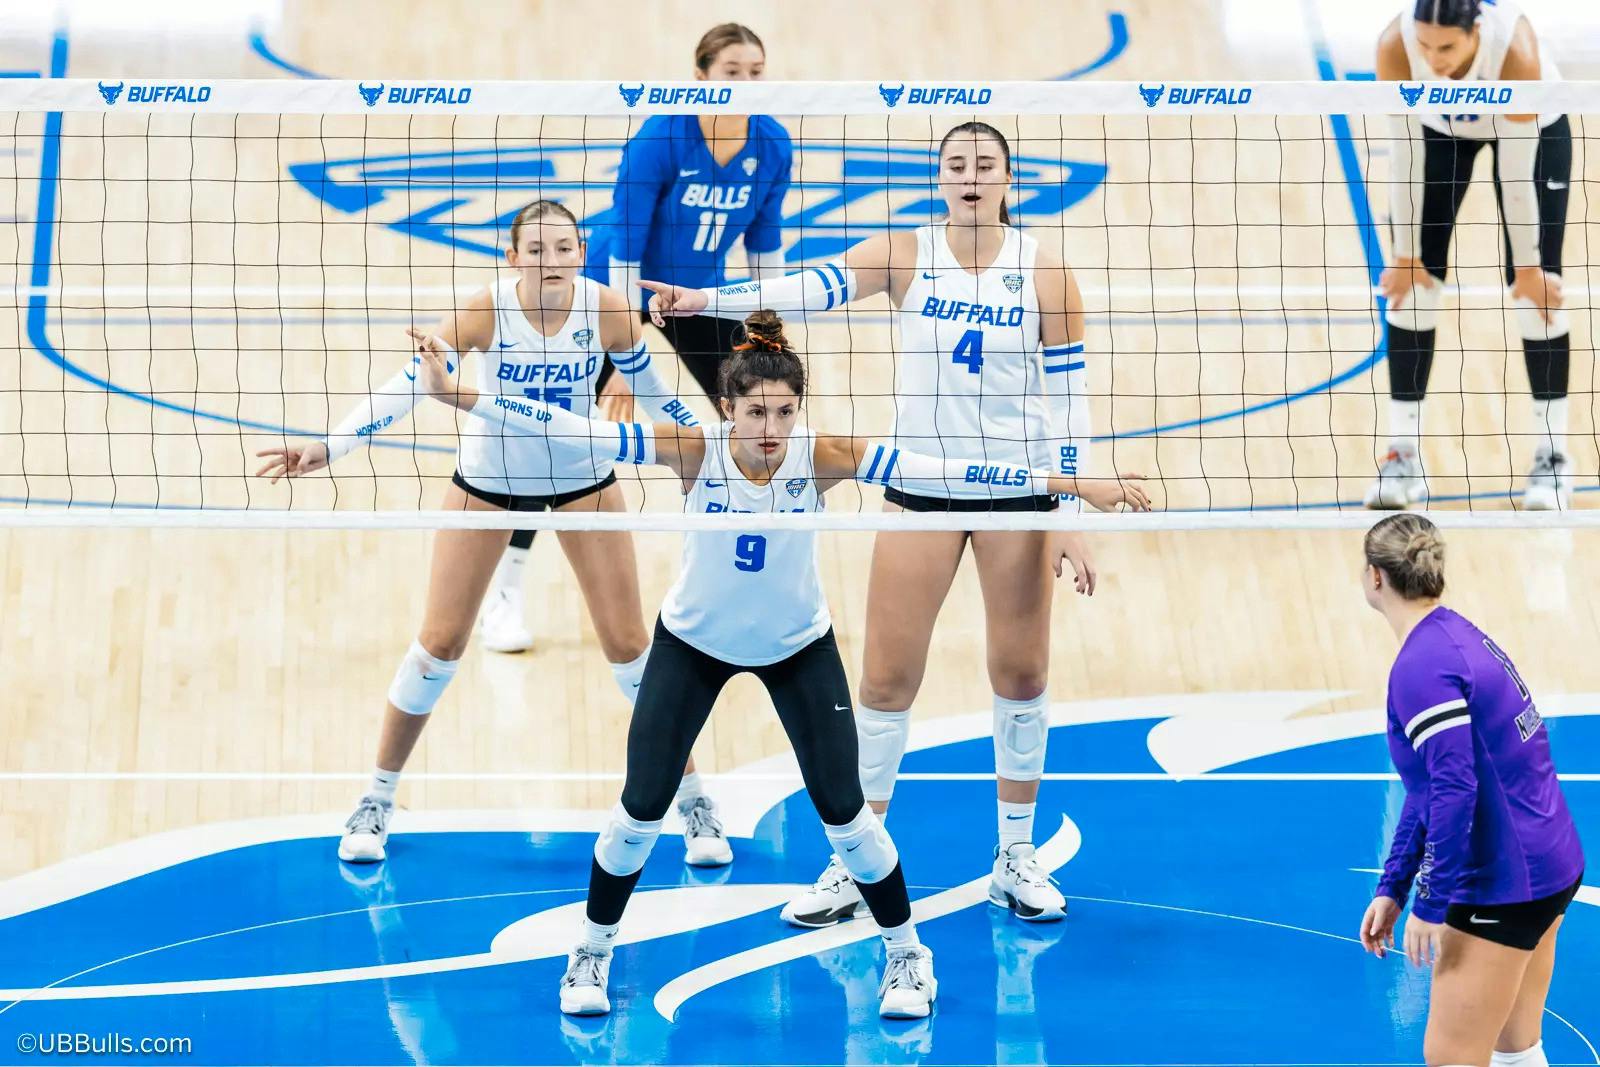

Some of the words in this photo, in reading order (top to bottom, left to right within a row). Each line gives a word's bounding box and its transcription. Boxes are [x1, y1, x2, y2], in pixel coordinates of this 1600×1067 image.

[128, 86, 211, 103] BUFFALO
[388, 87, 472, 104] BUFFALO
[648, 88, 732, 104] BUFFALO
[908, 88, 992, 105] BUFFALO
[1168, 88, 1252, 104] BUFFALO
[1428, 88, 1512, 104] BUFFALO
[680, 184, 752, 210] BULLS
[692, 211, 729, 253] 11
[719, 285, 748, 296] HORNS
[921, 296, 1025, 327] BUFFALO
[951, 329, 985, 375] 4
[497, 356, 597, 383] BUFFALO
[494, 395, 533, 417] HORNS
[536, 409, 553, 423] UP
[355, 419, 382, 439] HORNS
[383, 415, 394, 427] UP
[964, 465, 1029, 487] BULLS
[734, 534, 767, 573] 9
